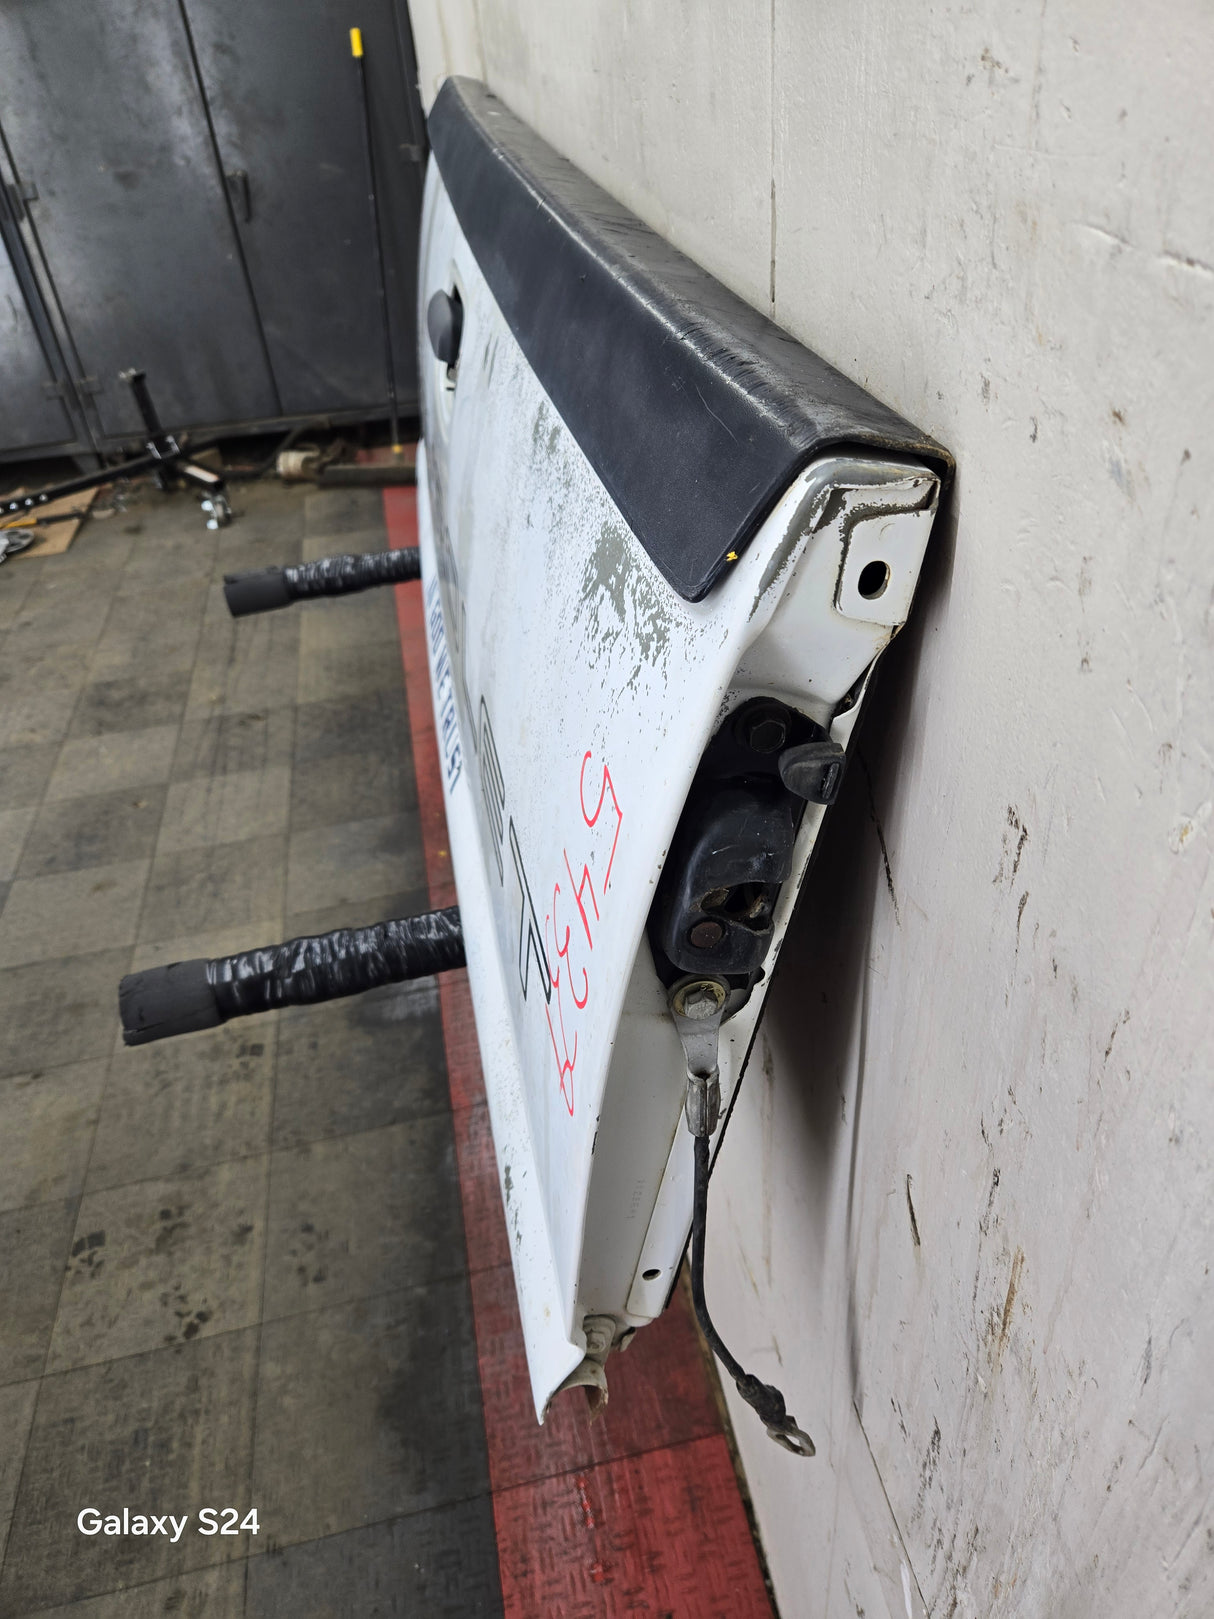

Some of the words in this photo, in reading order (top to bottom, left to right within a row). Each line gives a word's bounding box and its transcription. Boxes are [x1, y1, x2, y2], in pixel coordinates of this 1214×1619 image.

[430, 598, 445, 656] GOD
[436, 645, 450, 701] WE
[440, 687, 462, 795] TRUST
